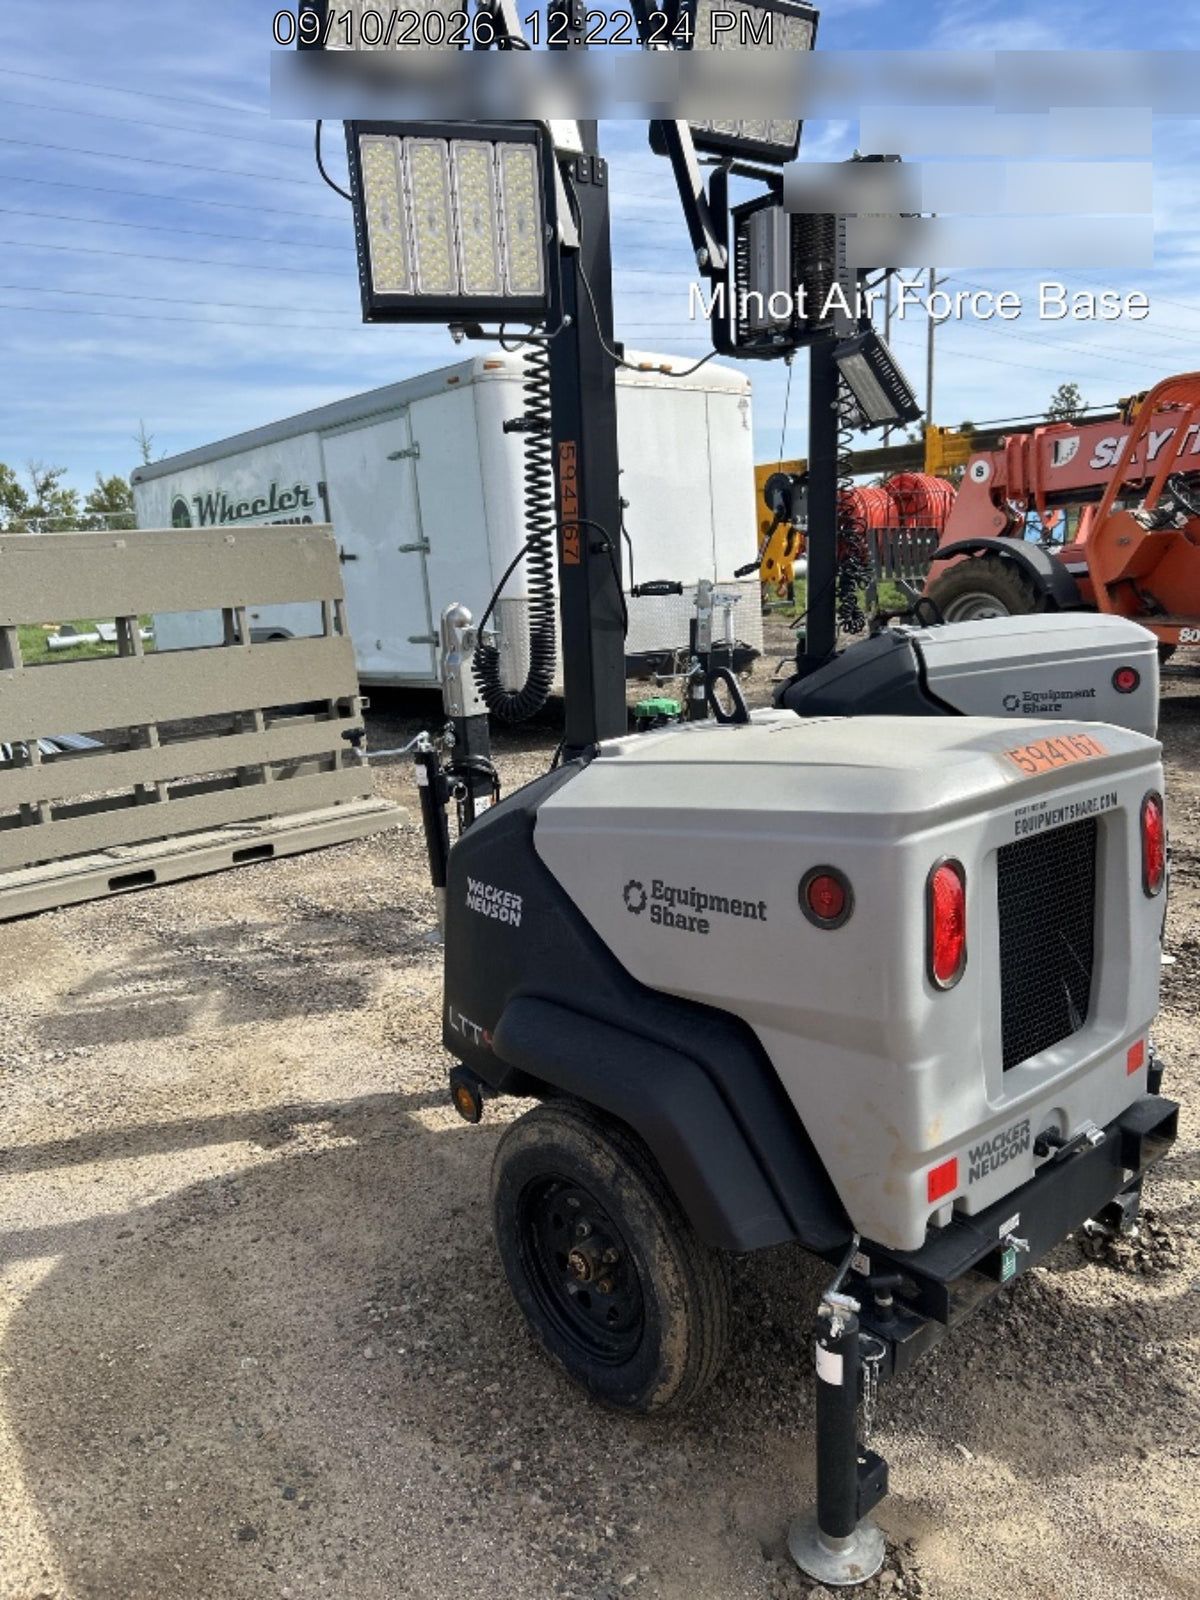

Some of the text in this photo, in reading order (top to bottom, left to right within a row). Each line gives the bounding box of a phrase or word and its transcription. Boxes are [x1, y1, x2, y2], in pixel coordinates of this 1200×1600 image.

[192, 481, 316, 527] Wheeler
[560, 444, 578, 560] 594167
[1022, 687, 1096, 702] Equipment
[1022, 702, 1063, 714] Share
[1014, 792, 1118, 836] EQUIPMENTSHARE.COM
[465, 892, 522, 928] NEUSON
[467, 876, 524, 911] WACKER
[651, 879, 768, 922] Equipment
[650, 904, 710, 935] Share
[968, 1118, 1031, 1166] WACKER
[968, 1135, 1031, 1185] NEUSON
